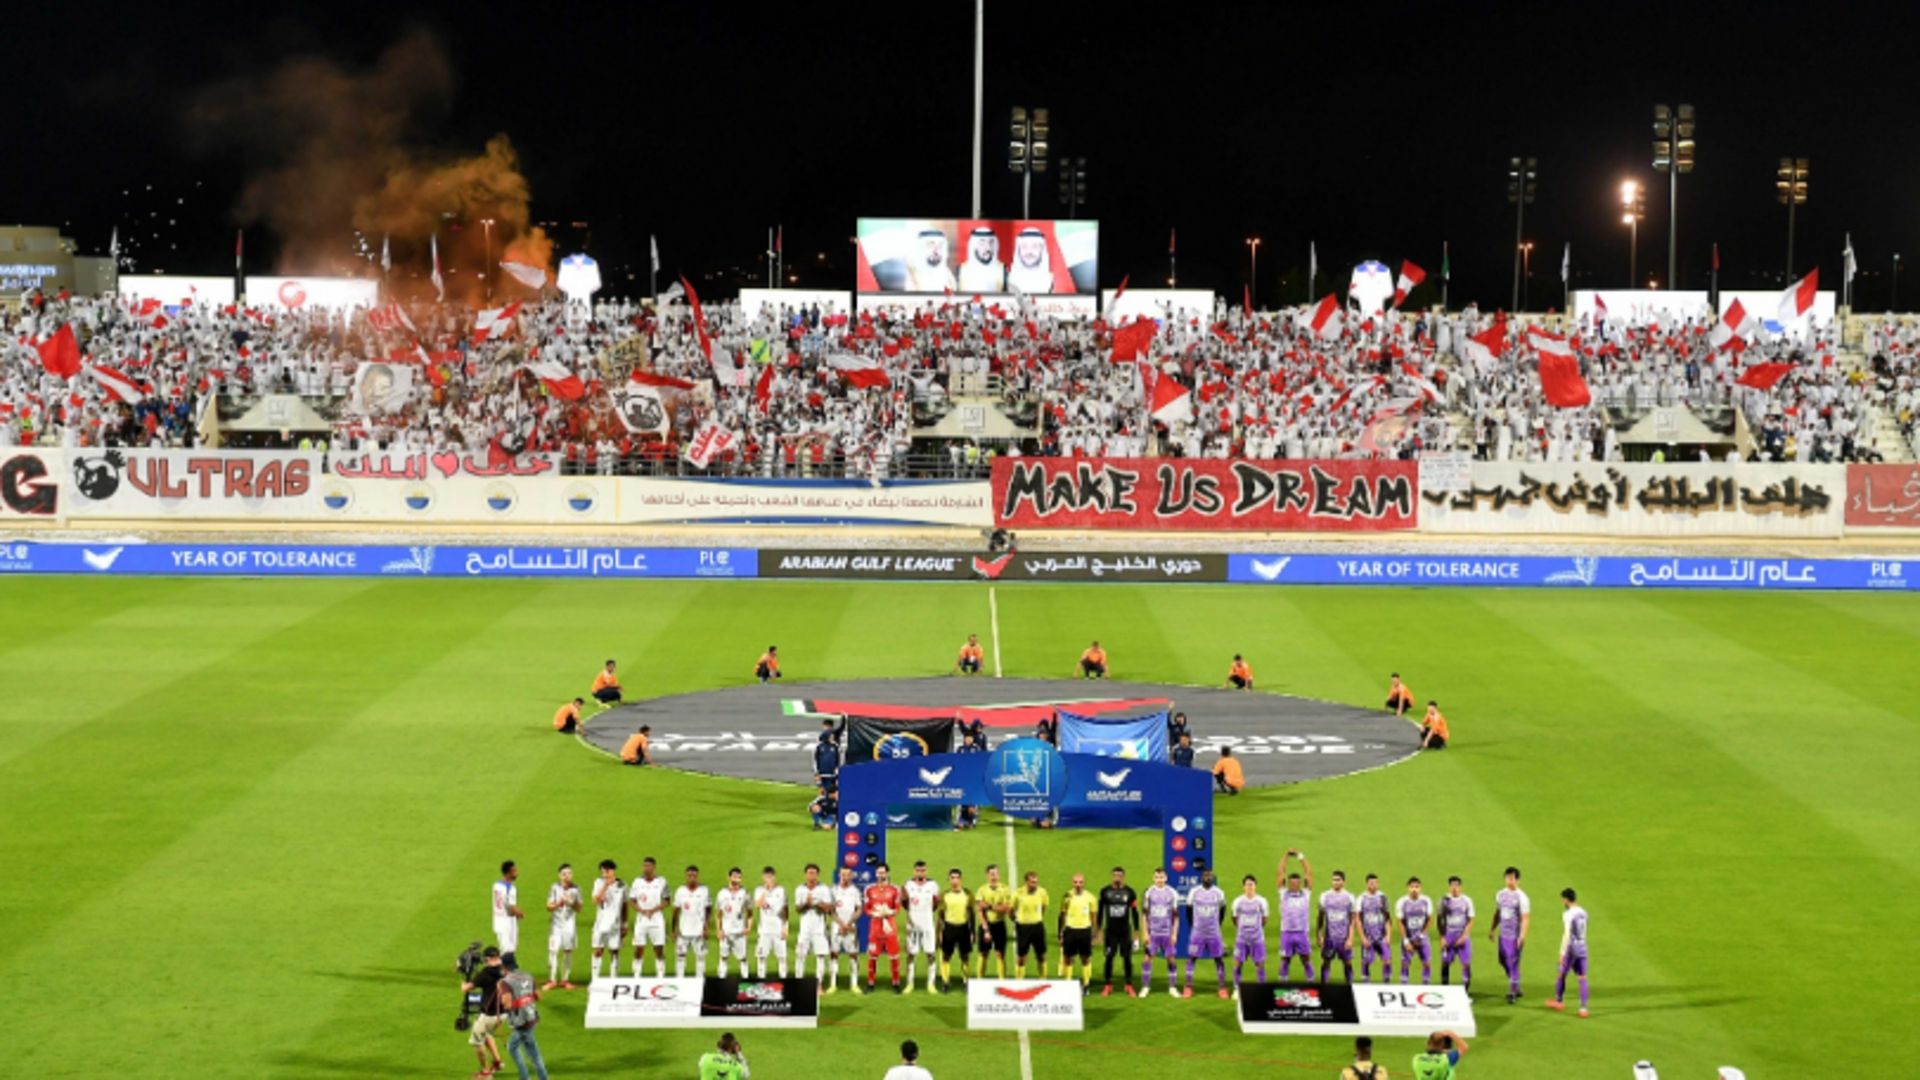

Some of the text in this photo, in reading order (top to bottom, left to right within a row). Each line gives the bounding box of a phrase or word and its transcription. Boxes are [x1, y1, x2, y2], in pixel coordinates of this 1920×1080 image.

[127, 456, 311, 499] ULTRAS
[1002, 461, 1139, 519] MAKE
[1154, 463, 1223, 516] US
[1231, 461, 1411, 519] DREAM
[171, 551, 357, 568] YEAR OF TOLERANCE
[465, 548, 648, 575] عام التسامح
[778, 556, 848, 570] ARABIAN
[851, 556, 892, 570] GULF
[1023, 556, 1202, 576] دوري الخليج العربي
[1337, 560, 1520, 579] YEAR OF TOLERANCE
[1629, 559, 1816, 586] عام التسامح
[611, 983, 680, 1001] PLC
[1377, 991, 1446, 1009] PLC
